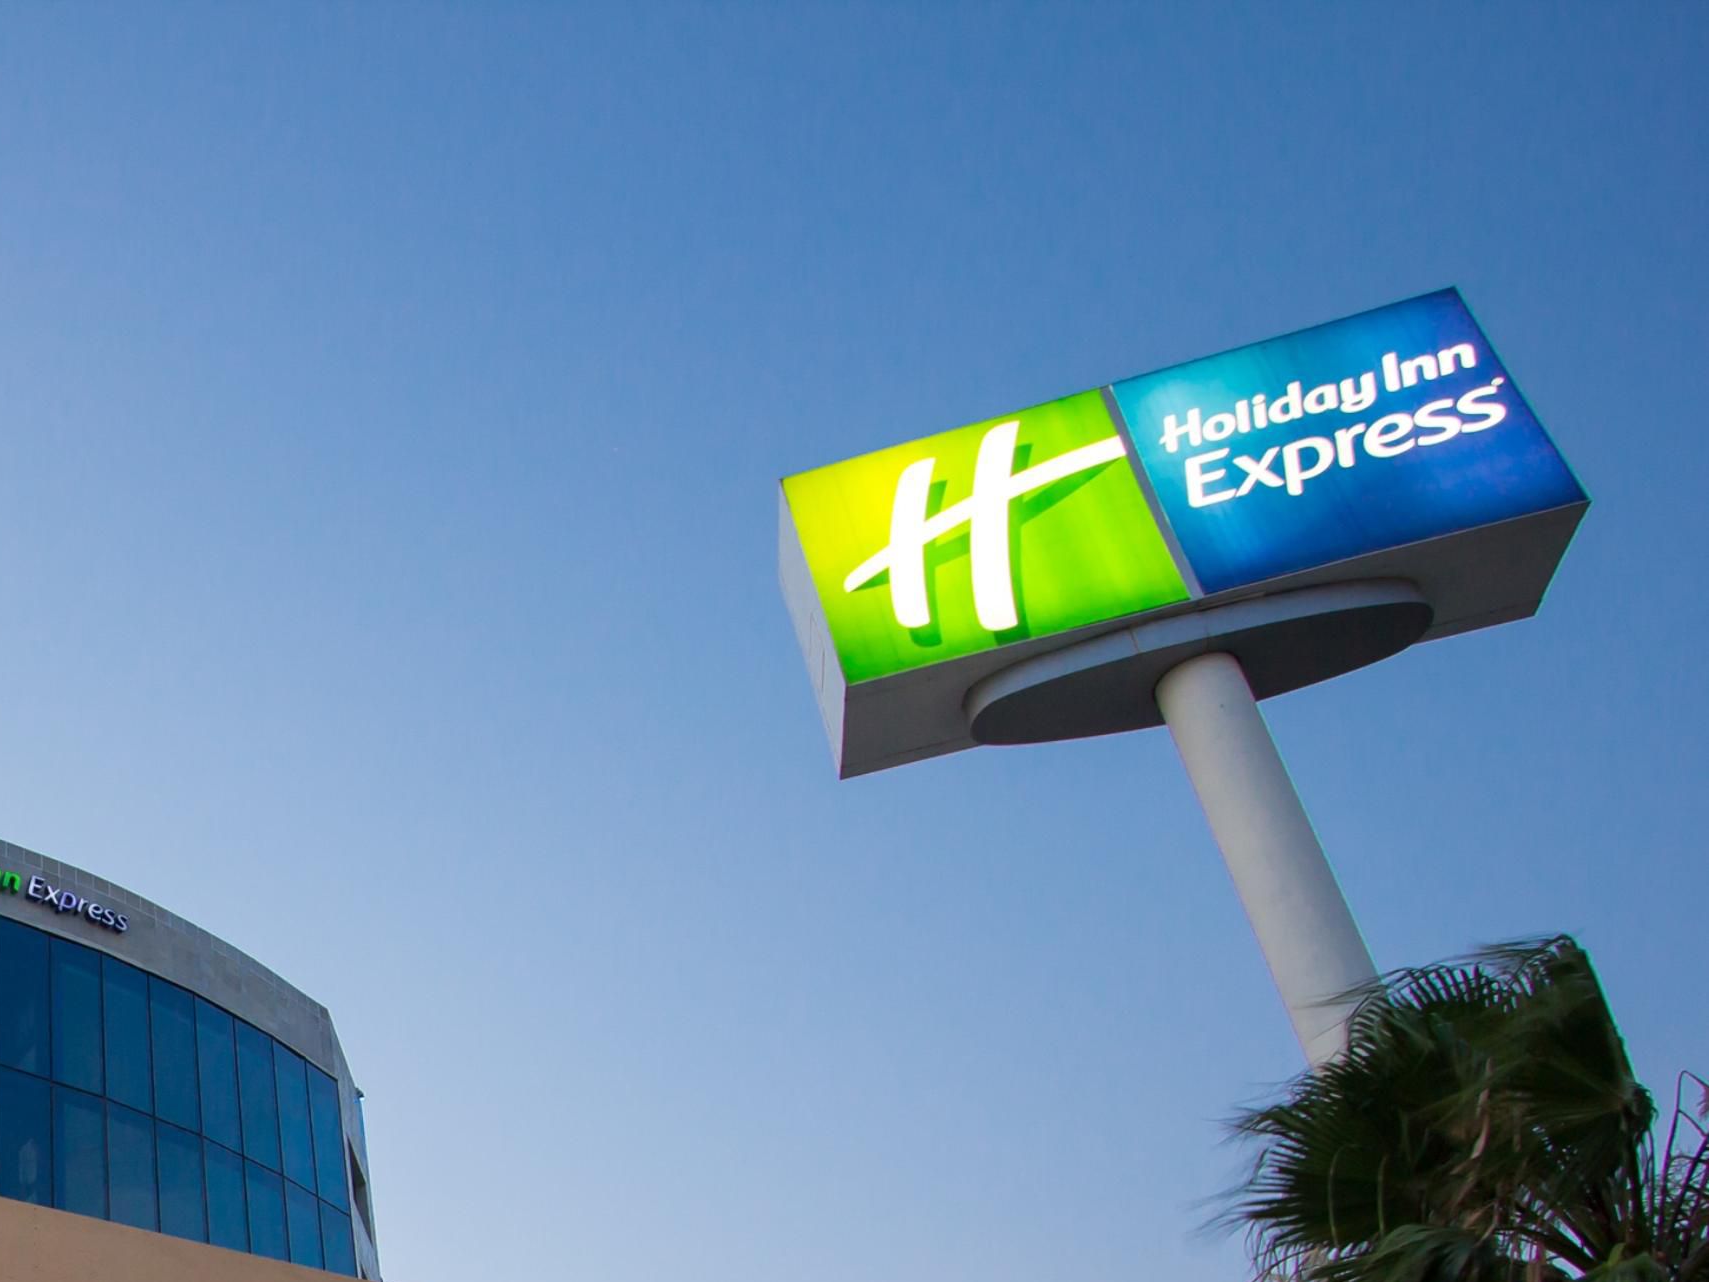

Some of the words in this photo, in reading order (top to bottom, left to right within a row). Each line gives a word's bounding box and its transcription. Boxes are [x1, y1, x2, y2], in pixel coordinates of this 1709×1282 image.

[1159, 372, 1377, 454] Holiday
[1381, 342, 1477, 393] Inn
[1184, 380, 1507, 509] Express
[25, 875, 131, 934] Express
